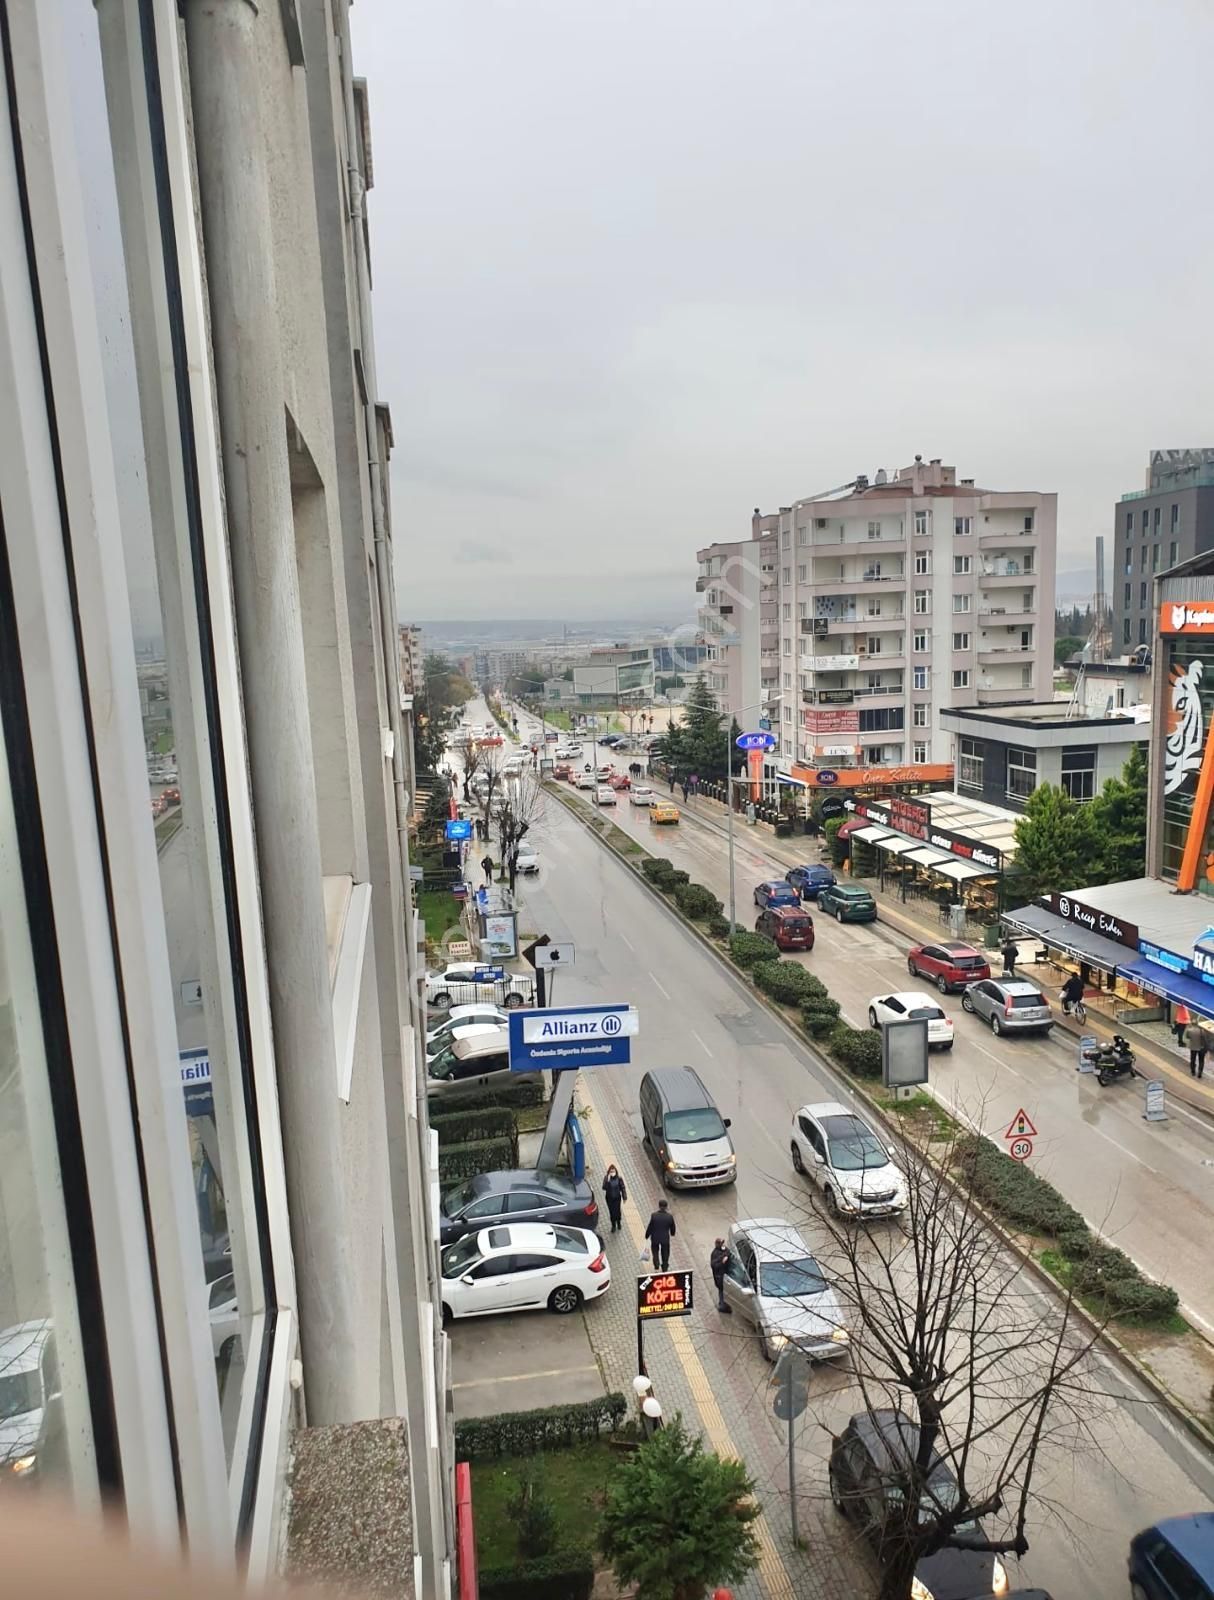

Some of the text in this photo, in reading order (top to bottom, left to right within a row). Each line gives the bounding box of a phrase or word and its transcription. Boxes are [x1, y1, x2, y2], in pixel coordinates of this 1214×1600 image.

[1074, 904, 1123, 936] Recep Erden
[542, 1021, 598, 1036] Allianz
[1015, 1144, 1029, 1154] 30
[647, 1289, 683, 1304] KÖFTE
